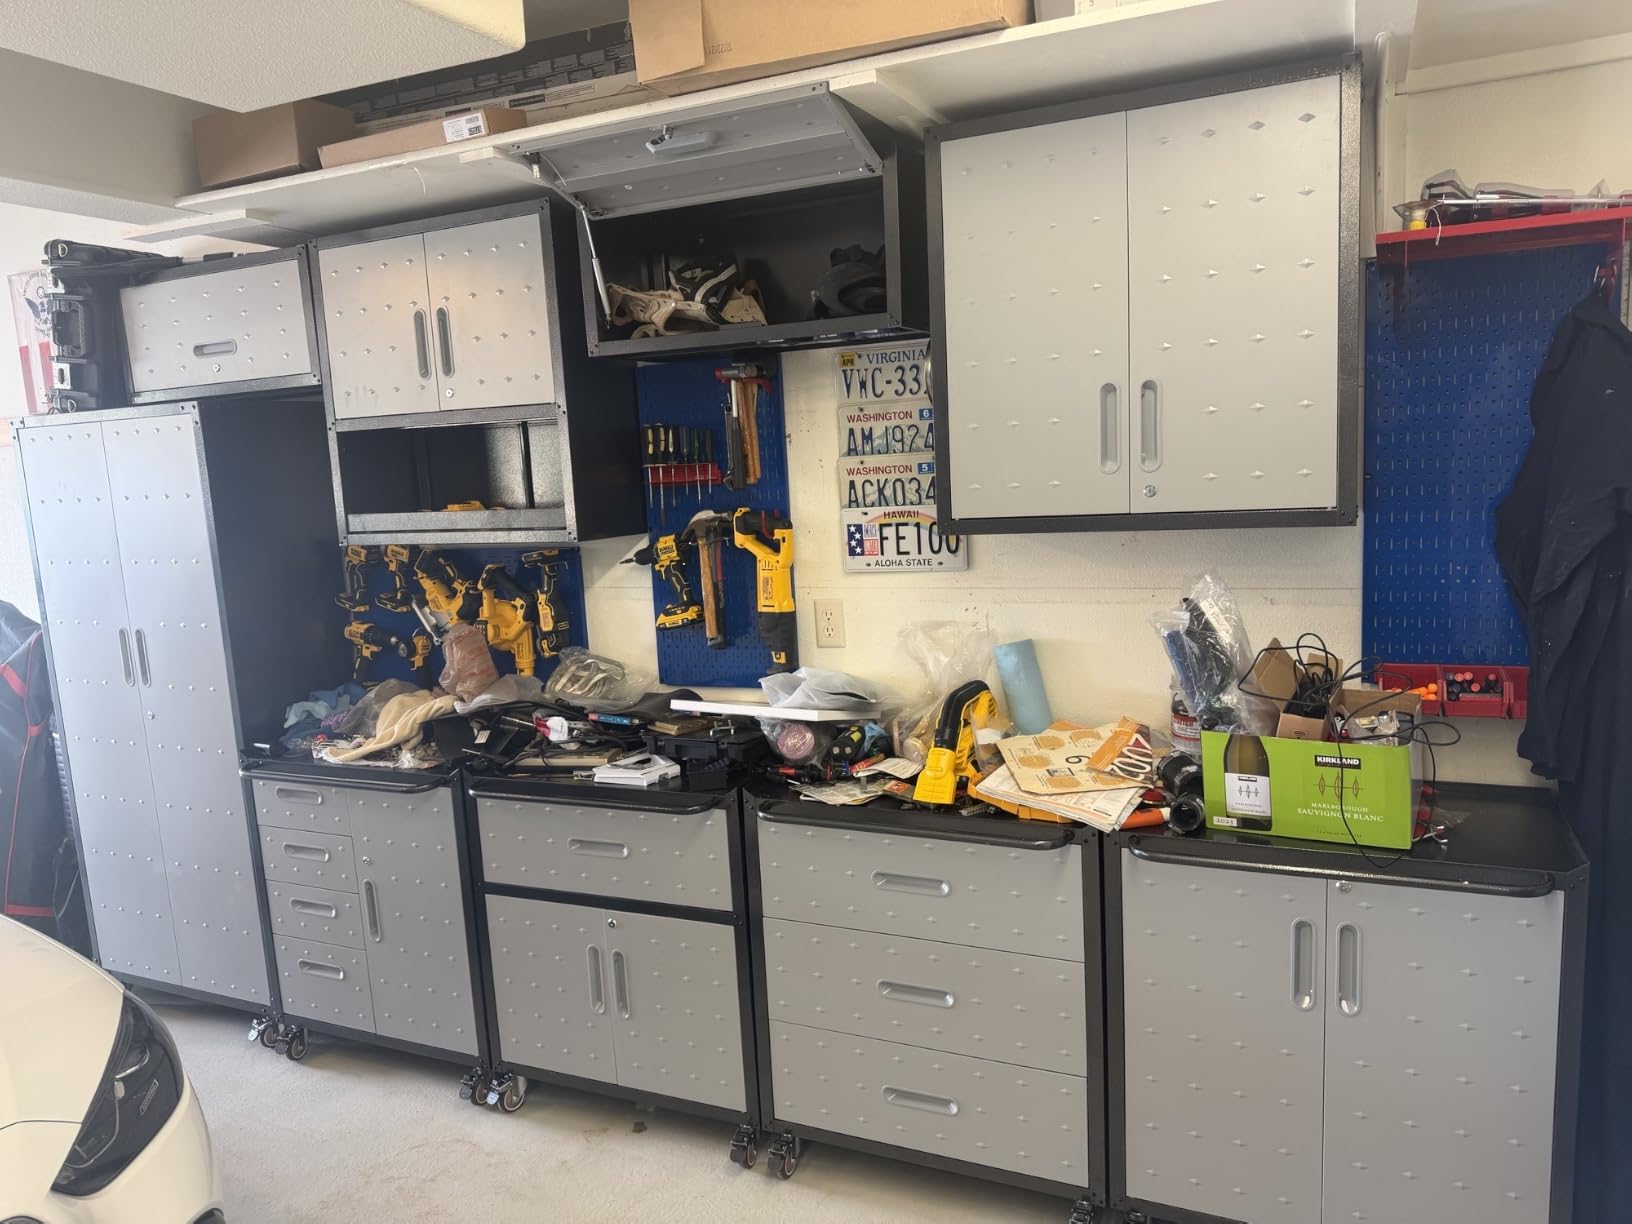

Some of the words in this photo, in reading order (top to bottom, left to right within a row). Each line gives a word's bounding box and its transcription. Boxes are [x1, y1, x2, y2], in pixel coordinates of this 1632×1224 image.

[842, 359, 855, 367] APR
[866, 349, 926, 364] VIRGINIA
[841, 364, 929, 400] VWC-33
[847, 410, 913, 424] WASHINGTON
[923, 409, 930, 417] 6
[847, 422, 934, 456] AMJ924
[847, 464, 913, 477] WASHINGTON
[921, 463, 928, 471] 5
[848, 475, 936, 508] ACK034
[883, 510, 920, 519] HAWAII
[874, 559, 904, 567] ALOHA
[905, 558, 933, 567] STATE
[1316, 756, 1360, 765] KIRKLAND
[1296, 807, 1351, 819] SAUVIGNON
[1353, 813, 1384, 822] BLANC
